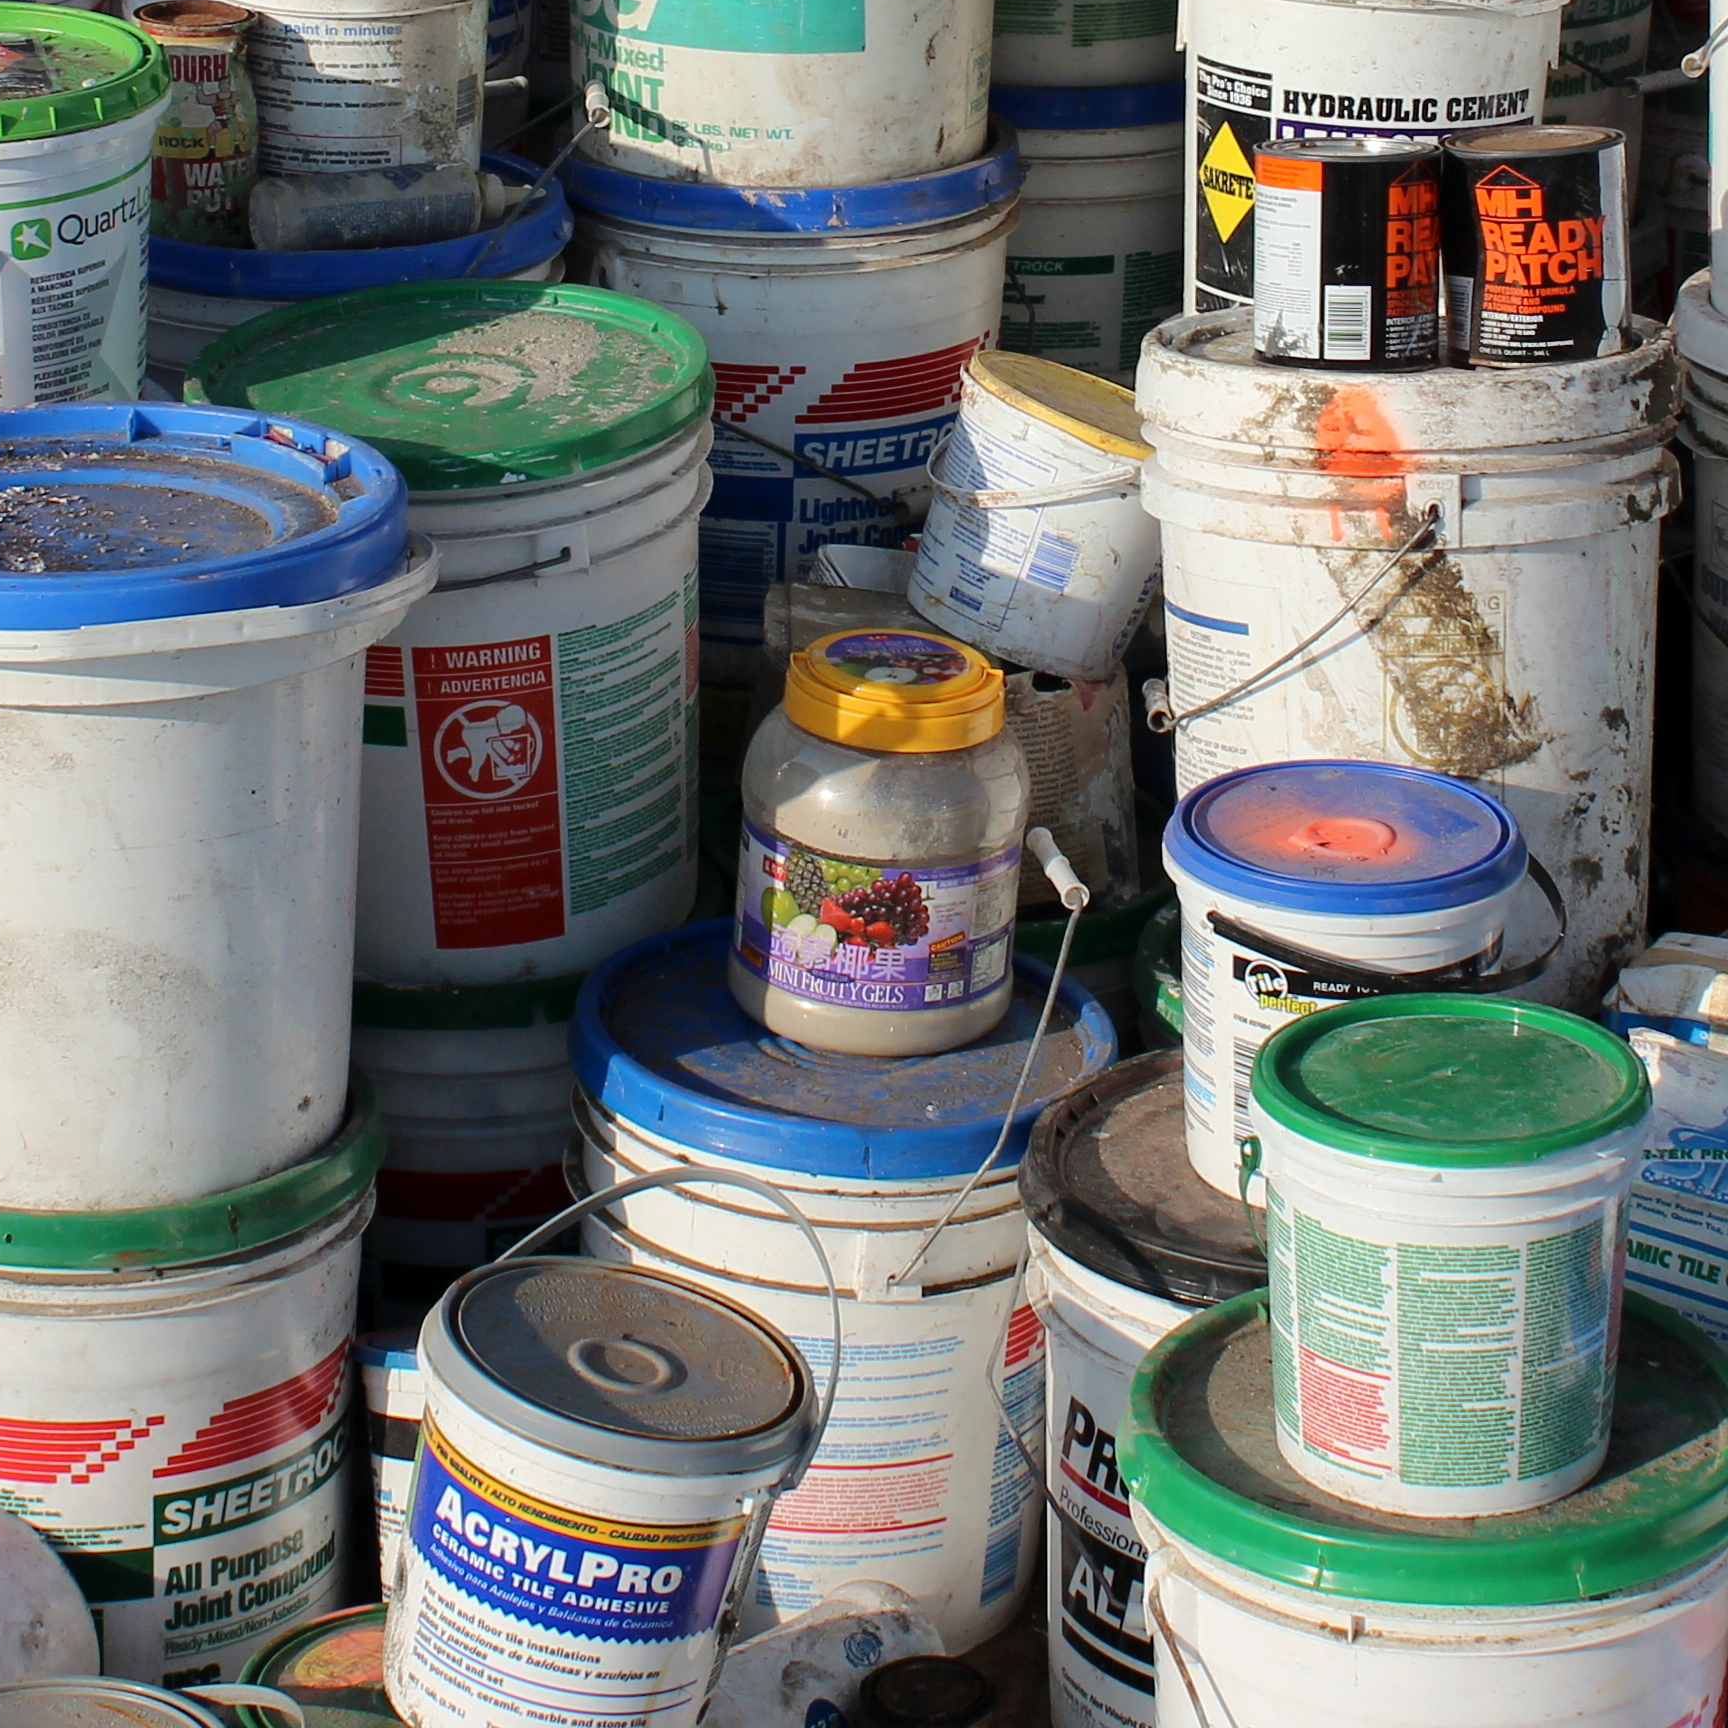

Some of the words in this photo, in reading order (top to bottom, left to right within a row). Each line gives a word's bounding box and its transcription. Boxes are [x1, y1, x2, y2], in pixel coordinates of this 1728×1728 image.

[283, 24, 319, 36] paint
[325, 24, 338, 36] in
[343, 24, 403, 36] minutes
[1198, 70, 1211, 84] The
[1212, 73, 1231, 91] Pro's
[1234, 80, 1268, 99] Choice
[1206, 84, 1228, 101] Since
[1230, 91, 1253, 107] 1936
[1282, 89, 1441, 123] HYDRAULIC
[1446, 88, 1530, 121] CEMENT
[158, 136, 204, 148] ROCK
[694, 122, 726, 137] LBS.
[730, 127, 760, 139] NET
[766, 128, 794, 140] WT.
[1202, 163, 1254, 201] SAKRETE
[1475, 188, 1542, 218] MH
[1483, 216, 1606, 256] READY
[1485, 249, 1603, 284] PATCH
[1484, 284, 1534, 297] PROFESSIONAL
[1536, 286, 1576, 296] FORMULA
[1484, 293, 1522, 305] SPACKLING
[1523, 297, 1540, 305] AND
[1518, 304, 1565, 314] COMPOUND
[445, 642, 542, 669] WARNING
[440, 670, 546, 695] ADVERTENCIA
[930, 932, 966, 952] CAUTION
[767, 959, 799, 986] MINI
[801, 970, 861, 1000] FRUITY
[862, 984, 905, 1005] GELS
[1313, 981, 1351, 993] READY
[1260, 994, 1317, 1016] perfect
[1677, 1253, 1721, 1284] TILE
[491, 1489, 516, 1508] ALTO
[517, 1503, 597, 1535] RENDIMIENTO
[609, 1528, 661, 1544] CALIDAD
[164, 1561, 202, 1597] All
[211, 1529, 304, 1587] Purpose
[431, 1522, 505, 1581] CERAMIC
[511, 1572, 556, 1601] TILE
[562, 1591, 670, 1615] ADHESIVE
[164, 1587, 232, 1632] Joint
[238, 1530, 335, 1613] Compound
[428, 1542, 466, 1577] Adhesivo
[489, 1583, 537, 1614] Azulejos
[547, 1605, 602, 1628] Baldosas
[438, 1610, 506, 1657] instalaciones
[525, 1655, 582, 1678] baldosas
[594, 1669, 644, 1683] azulejos
[526, 1639, 602, 1665] installations
[1105, 1702, 1139, 1727] Weight
